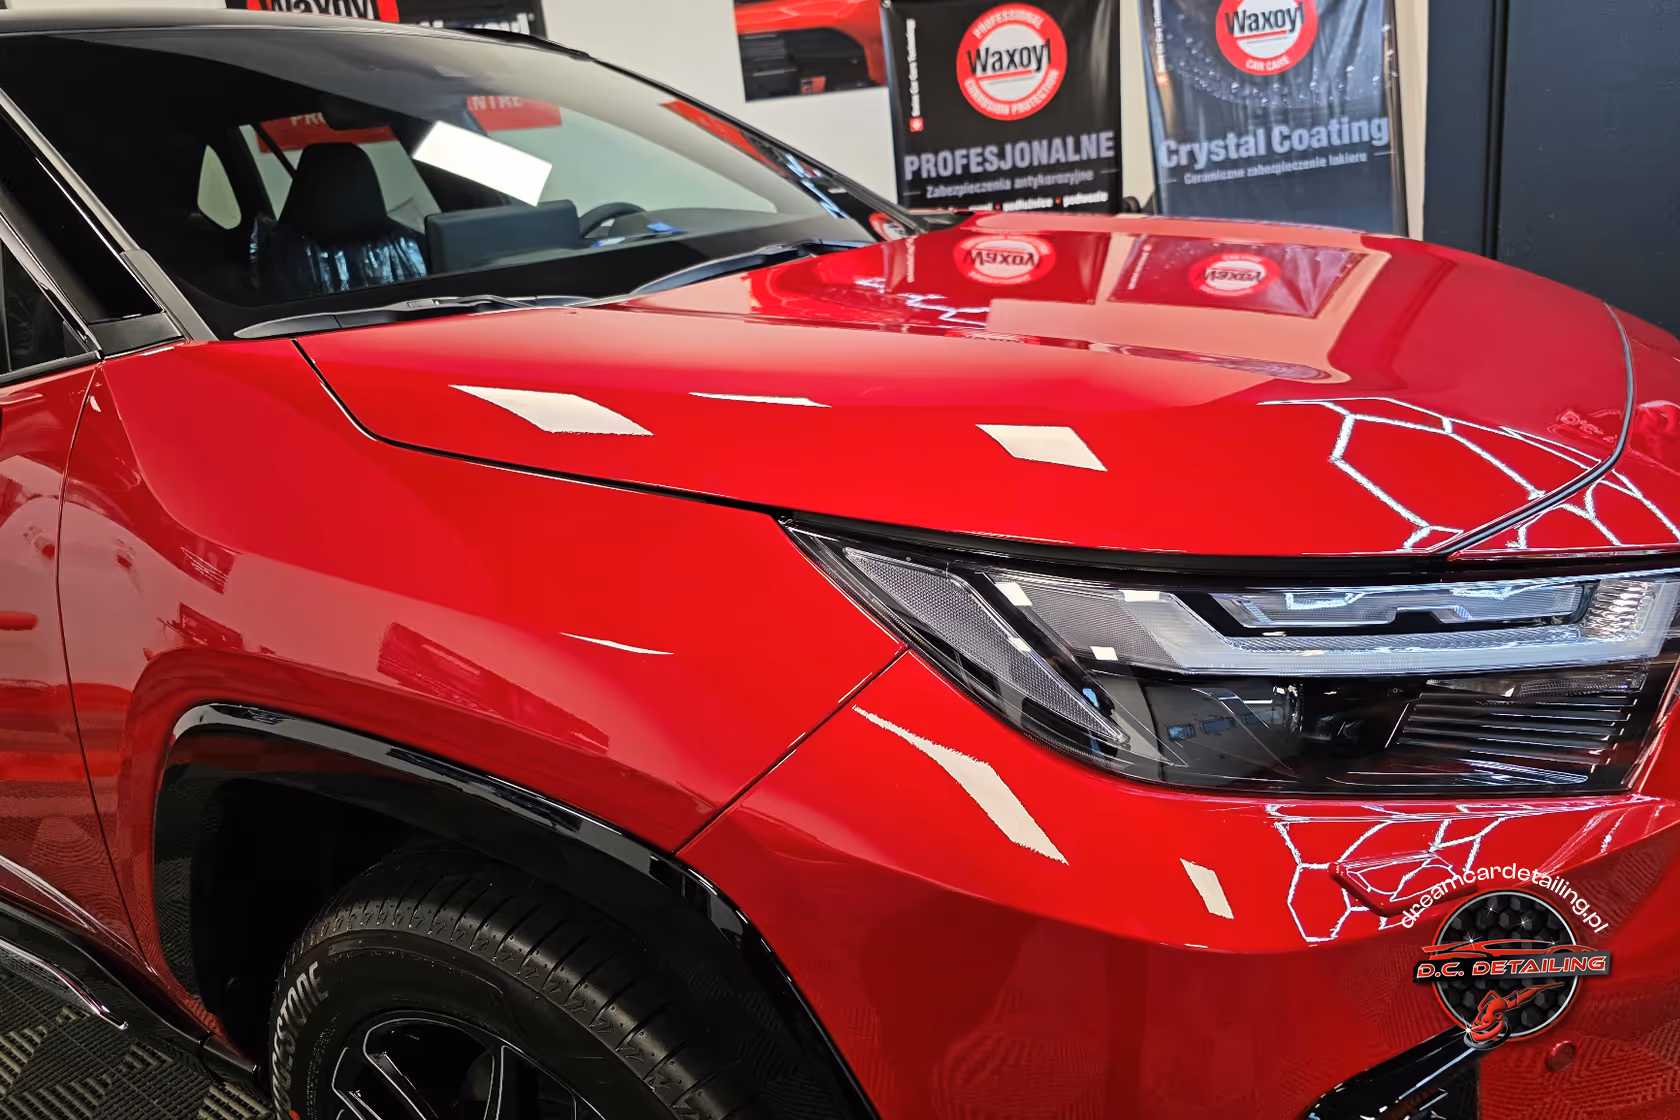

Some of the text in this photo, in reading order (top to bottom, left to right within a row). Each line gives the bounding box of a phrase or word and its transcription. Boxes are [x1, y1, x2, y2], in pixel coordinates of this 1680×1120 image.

[1224, 2, 1305, 35] Waxoyl
[966, 38, 1052, 75] Waxoyl
[903, 131, 1115, 181] PROFESJONALNE
[1159, 116, 1390, 170] Crystal Coating
[926, 168, 1094, 199] Zabezpieczenia antykorozyjne
